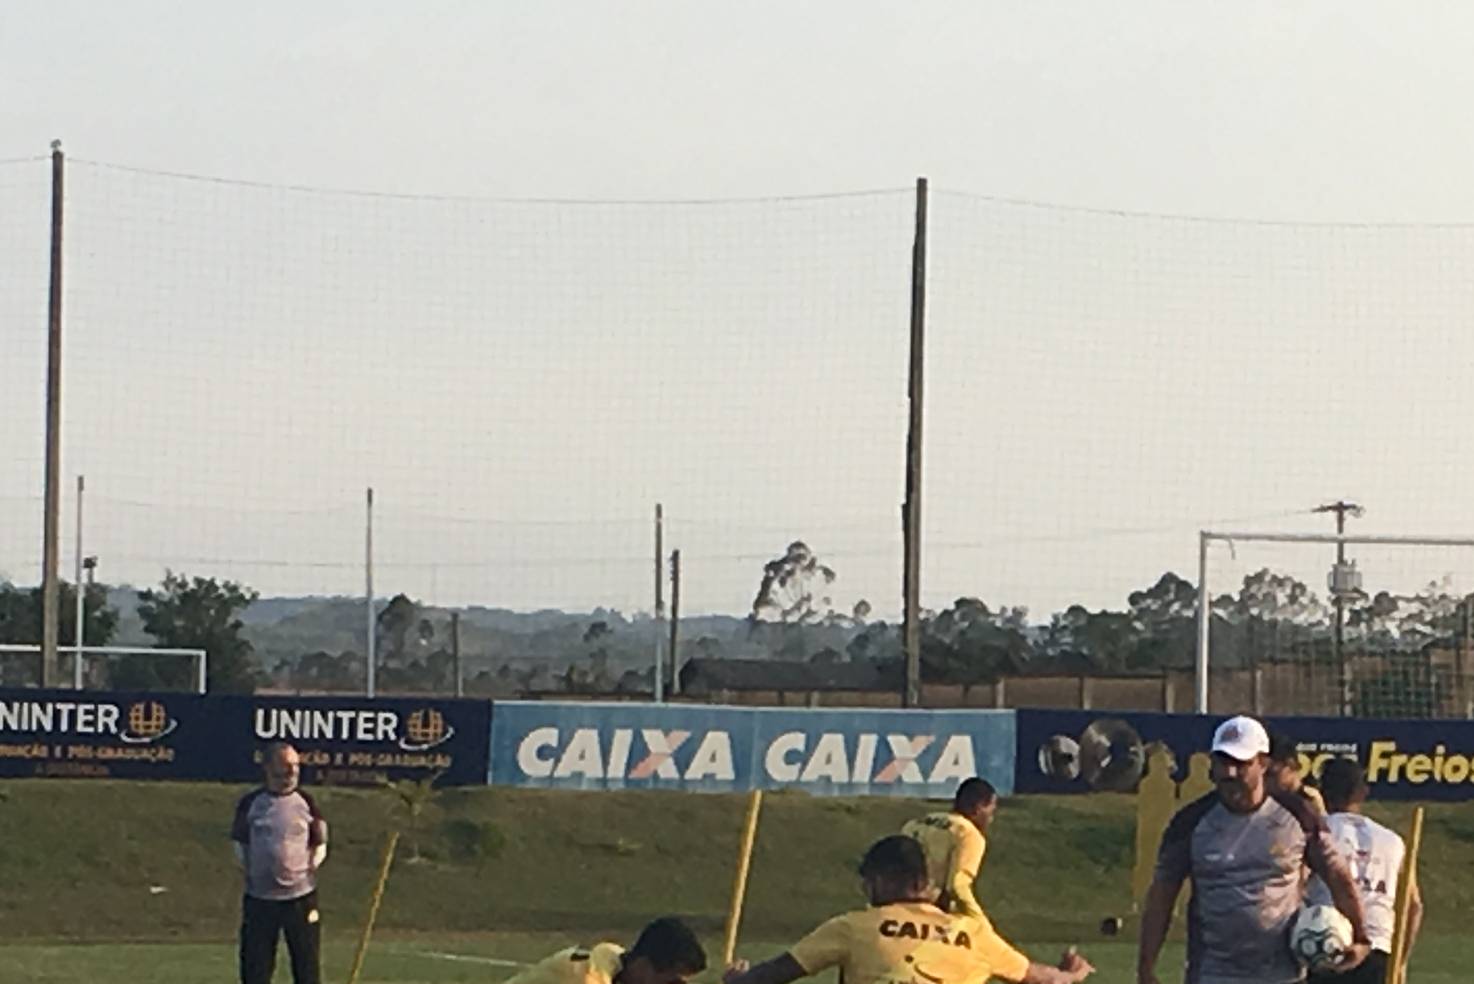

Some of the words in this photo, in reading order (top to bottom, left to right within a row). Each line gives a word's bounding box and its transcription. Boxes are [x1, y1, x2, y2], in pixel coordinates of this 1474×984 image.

[0, 702, 120, 734] NINTER
[255, 708, 399, 741] UNINTER
[517, 727, 735, 780] CAIXA
[764, 731, 978, 784] CAIXA
[879, 919, 972, 950] CAIXA
